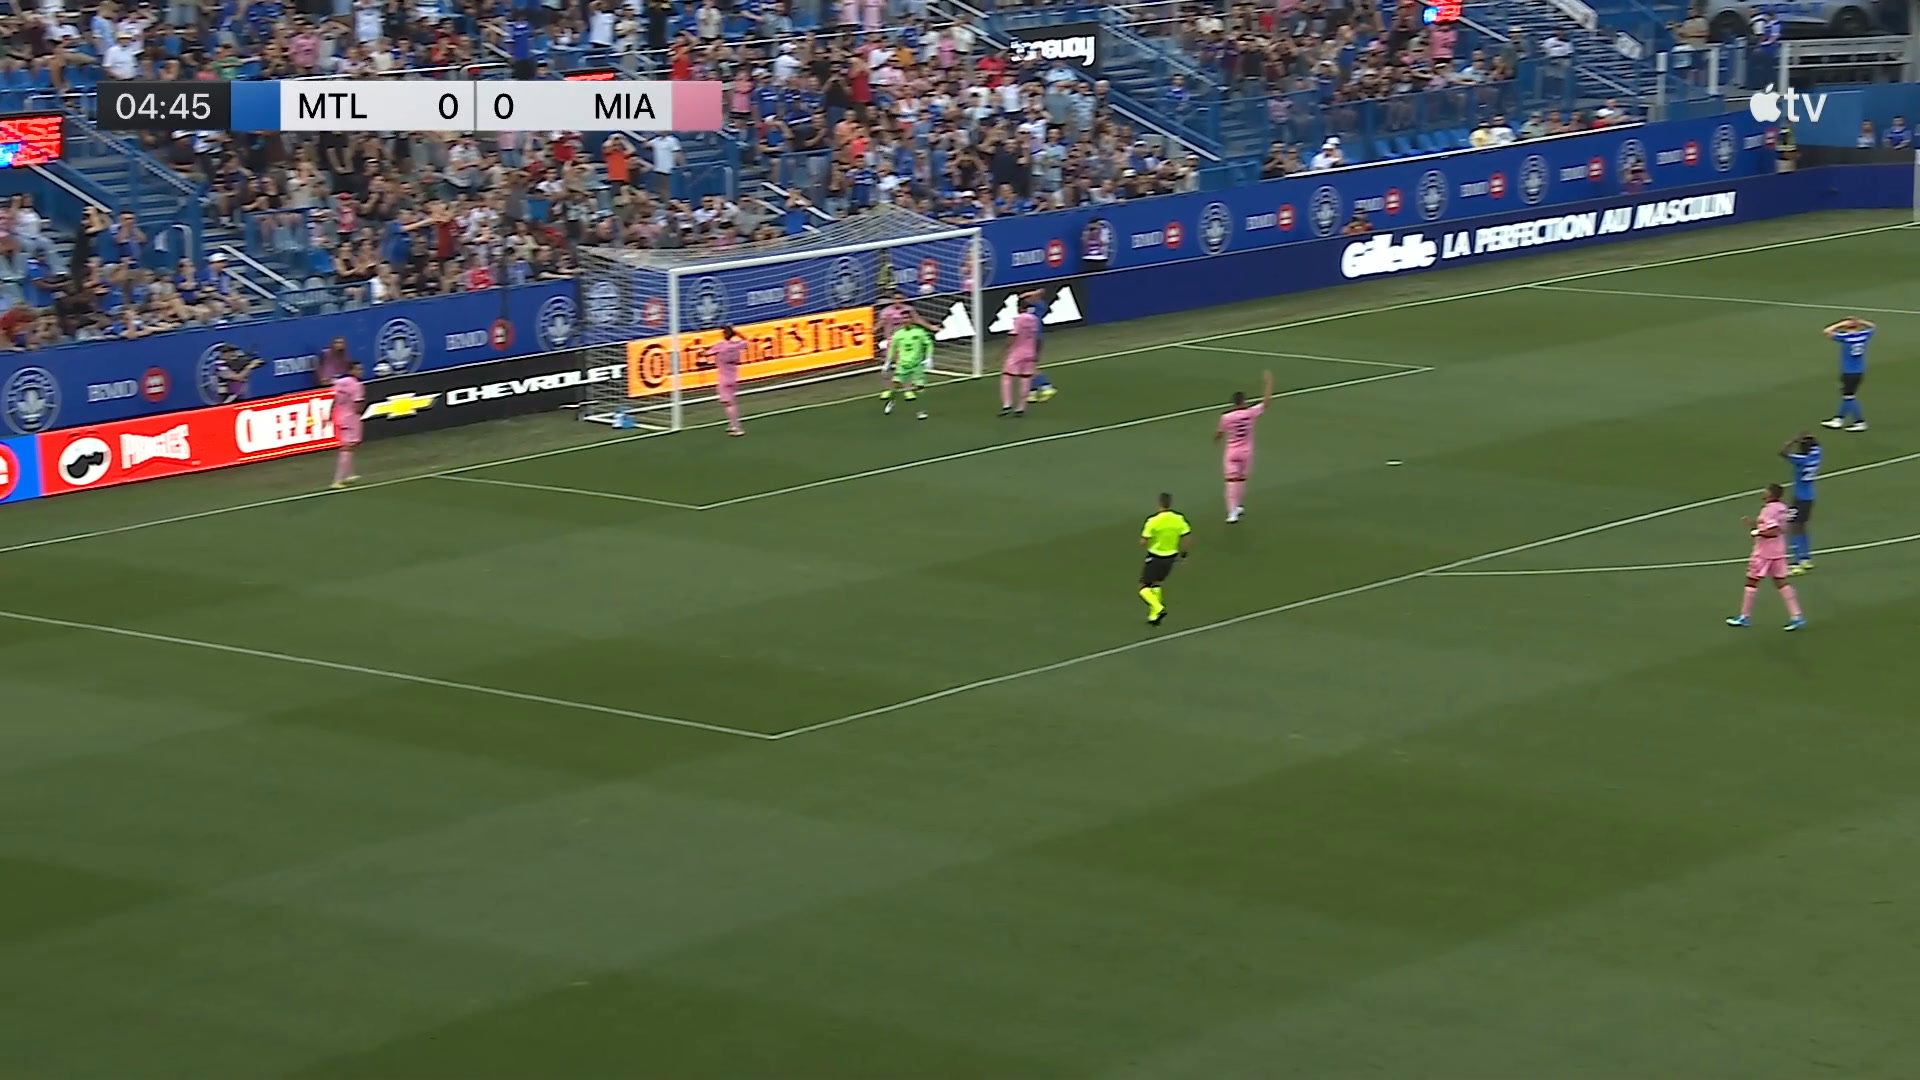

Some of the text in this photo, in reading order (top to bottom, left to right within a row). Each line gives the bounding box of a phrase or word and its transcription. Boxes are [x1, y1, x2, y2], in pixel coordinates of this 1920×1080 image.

[1341, 191, 1736, 278] Gillette LA PERFECTION AU MASCULIN
[807, 317, 867, 354] Tire
[446, 365, 626, 405] CHEVROLET
